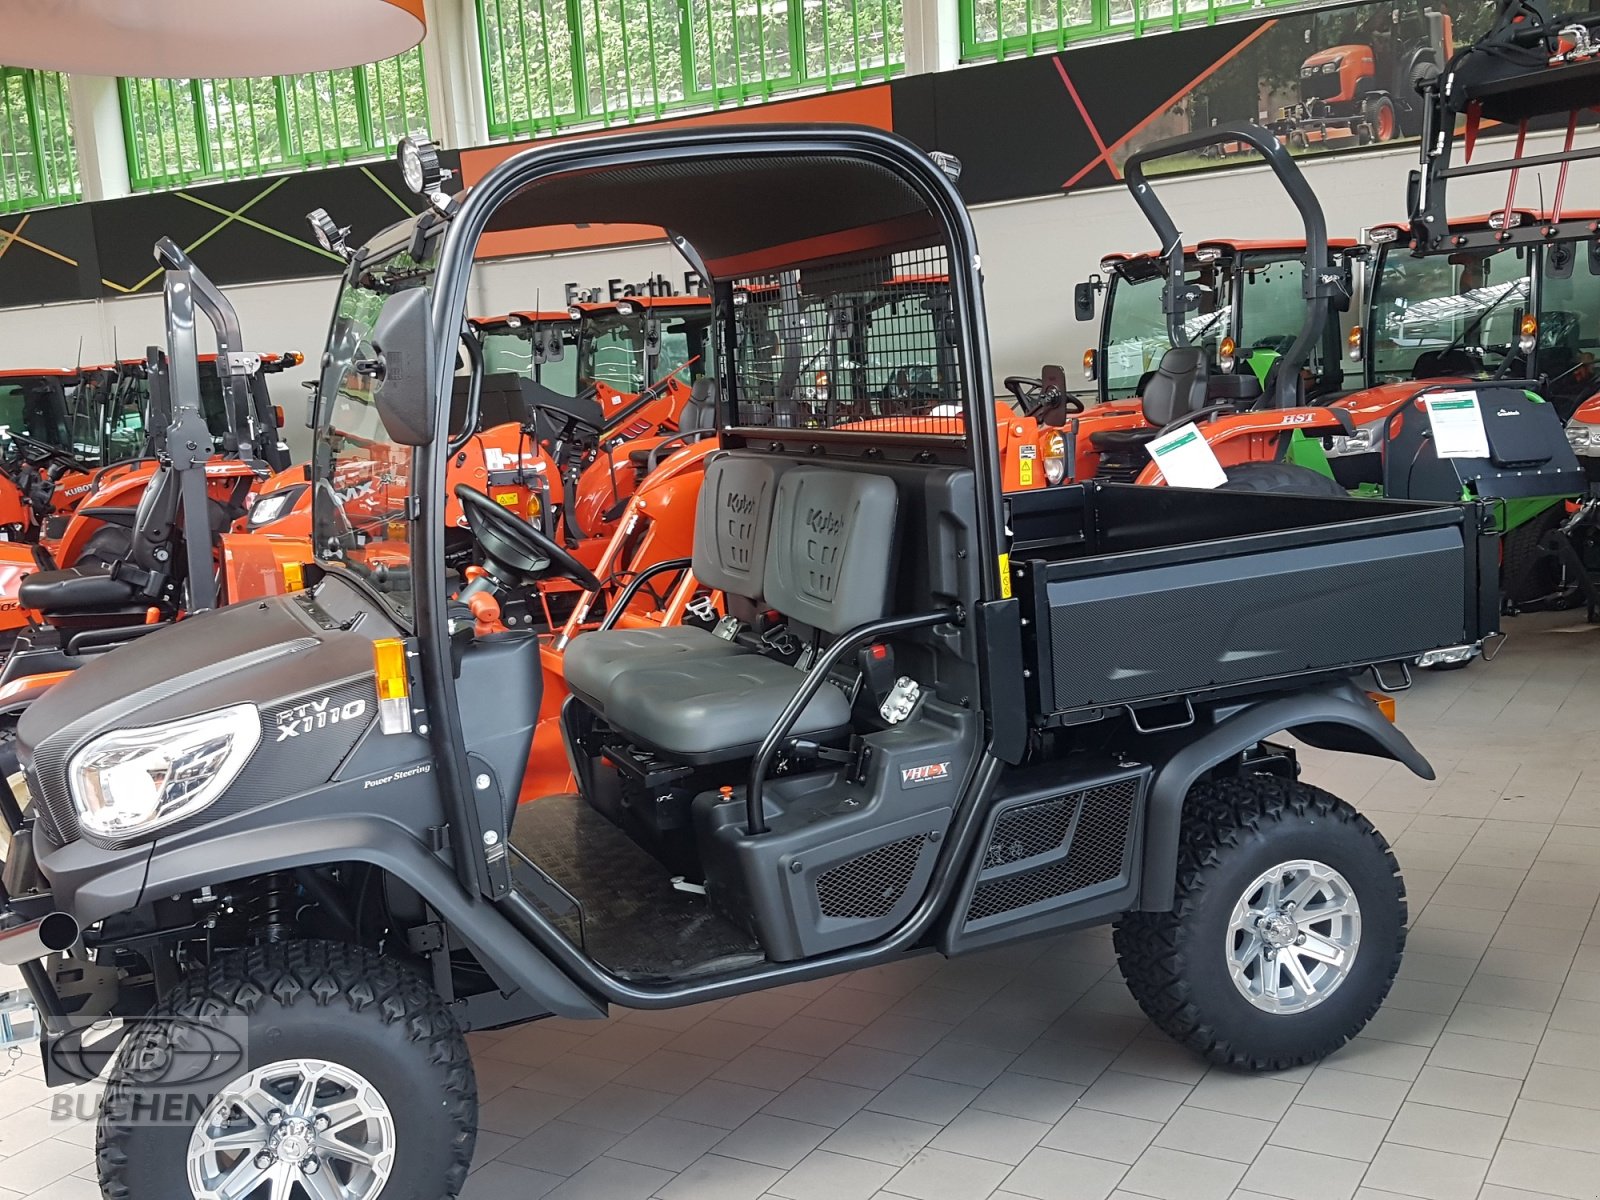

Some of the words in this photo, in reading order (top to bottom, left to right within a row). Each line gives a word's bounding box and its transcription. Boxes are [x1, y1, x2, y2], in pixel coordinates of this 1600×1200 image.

[565, 282, 602, 306] For
[608, 274, 680, 302] Earth,
[1281, 412, 1317, 425] HST
[64, 483, 101, 497] KUBOT
[276, 697, 330, 725] RTV
[276, 699, 366, 742] X1110
[363, 775, 393, 790] Power
[393, 764, 431, 781] Steering
